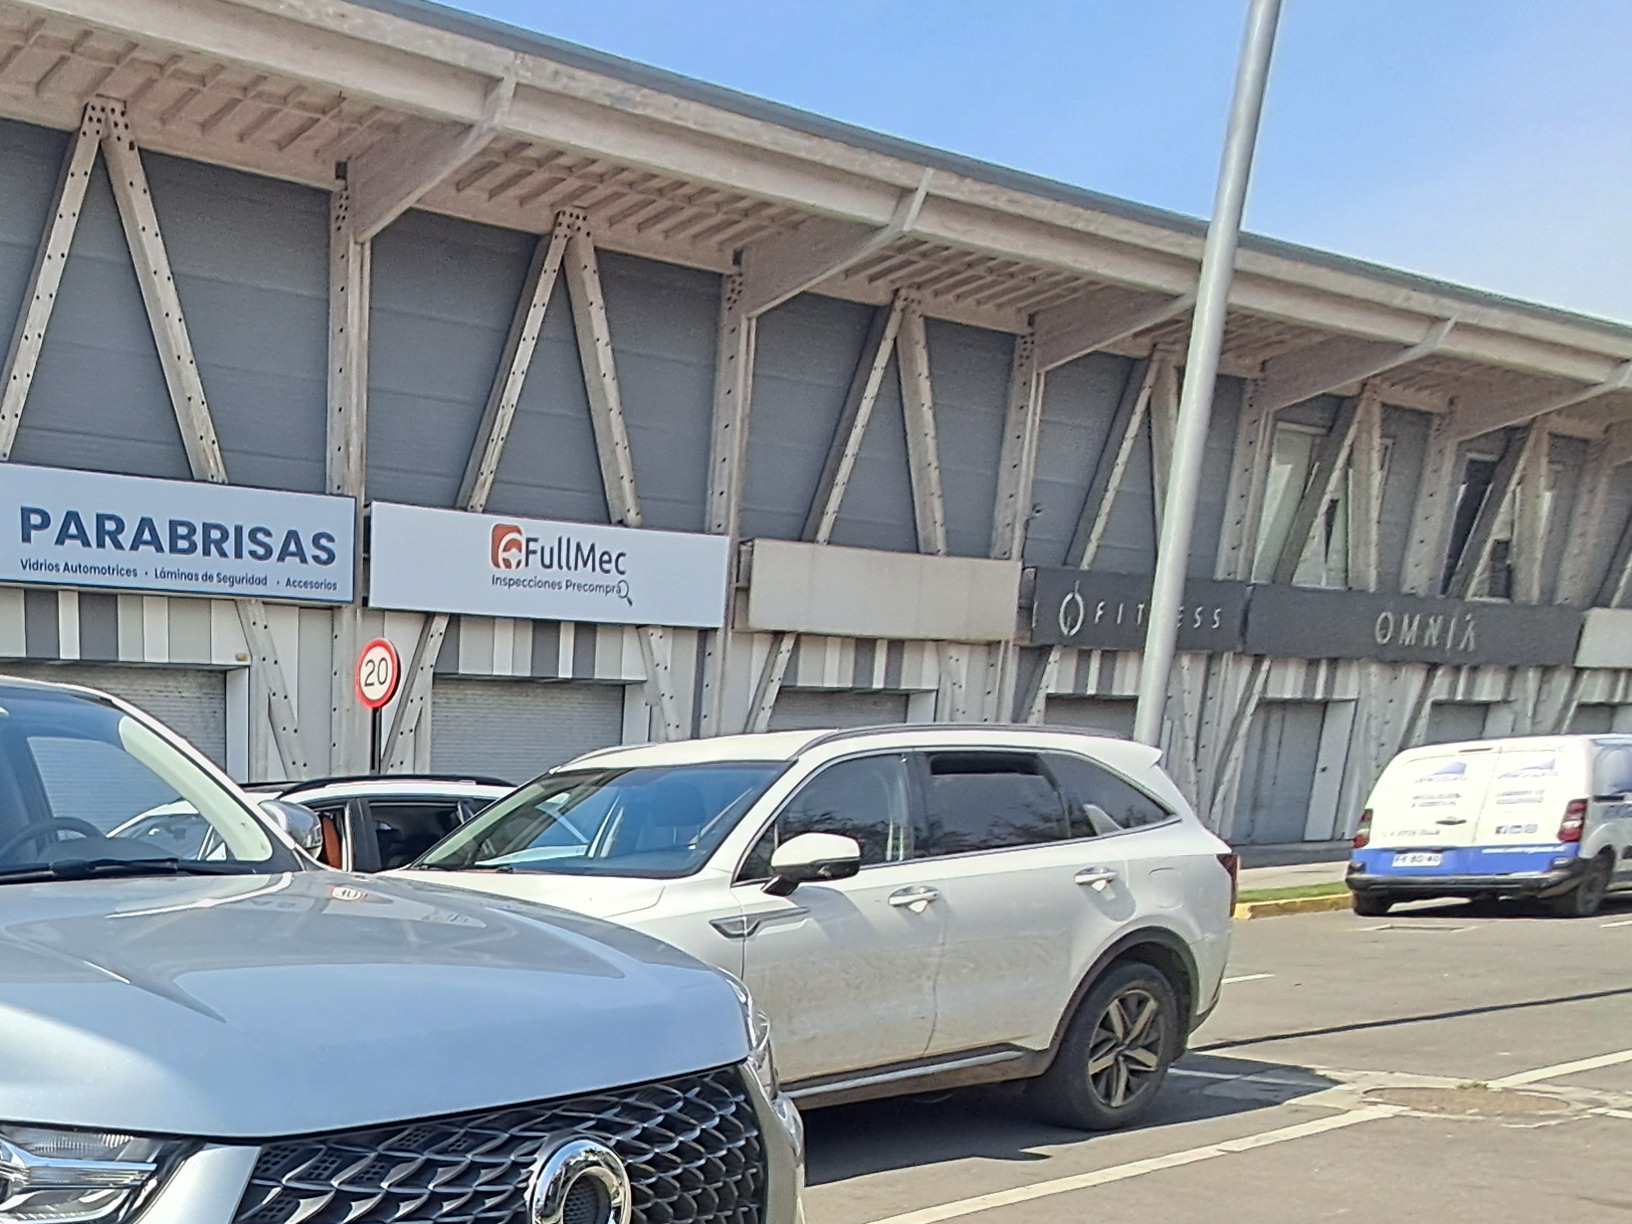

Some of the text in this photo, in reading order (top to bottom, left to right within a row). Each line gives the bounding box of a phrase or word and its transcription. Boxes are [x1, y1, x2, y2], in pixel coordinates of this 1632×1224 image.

[20, 506, 337, 566] PARABRISAS
[525, 535, 627, 575] FullMec
[20, 558, 338, 591] Vidrios Automotrices Láminas de Seguridad Accesorios
[491, 573, 622, 597] Inspecciones Precompra
[1094, 600, 1222, 629] FITESS
[363, 656, 389, 687] 20
